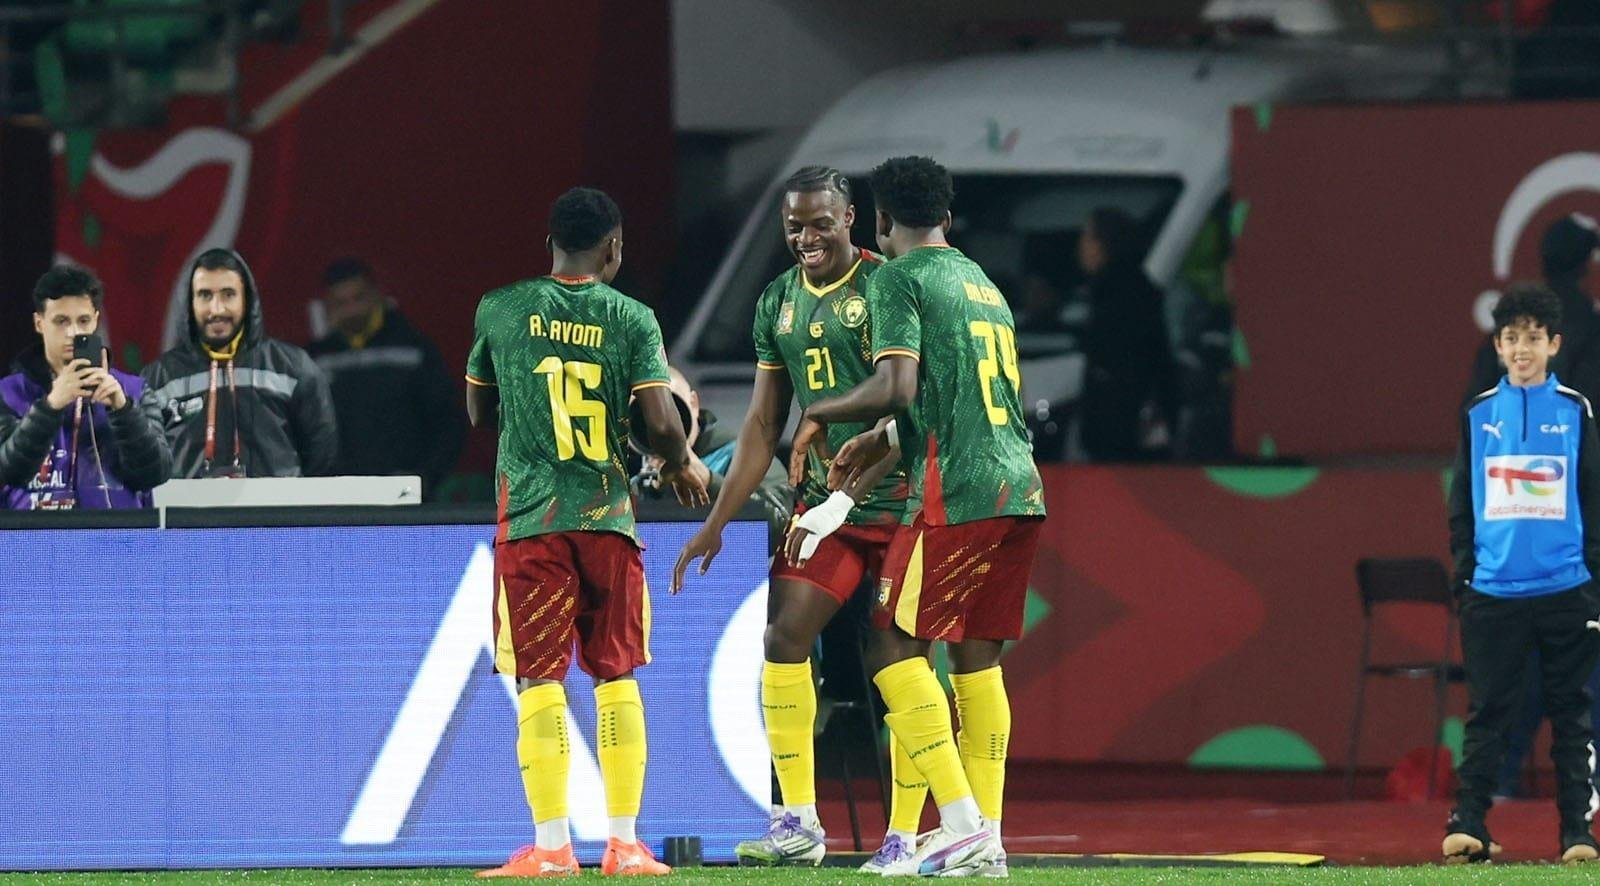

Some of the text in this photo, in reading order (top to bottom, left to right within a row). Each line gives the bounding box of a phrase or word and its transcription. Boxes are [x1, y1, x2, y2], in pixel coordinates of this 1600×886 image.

[529, 315, 603, 348] A. AVOM
[804, 347, 836, 391] 21
[969, 319, 1021, 427] 24
[532, 355, 609, 462] 15
[1539, 423, 1570, 434] CAF
